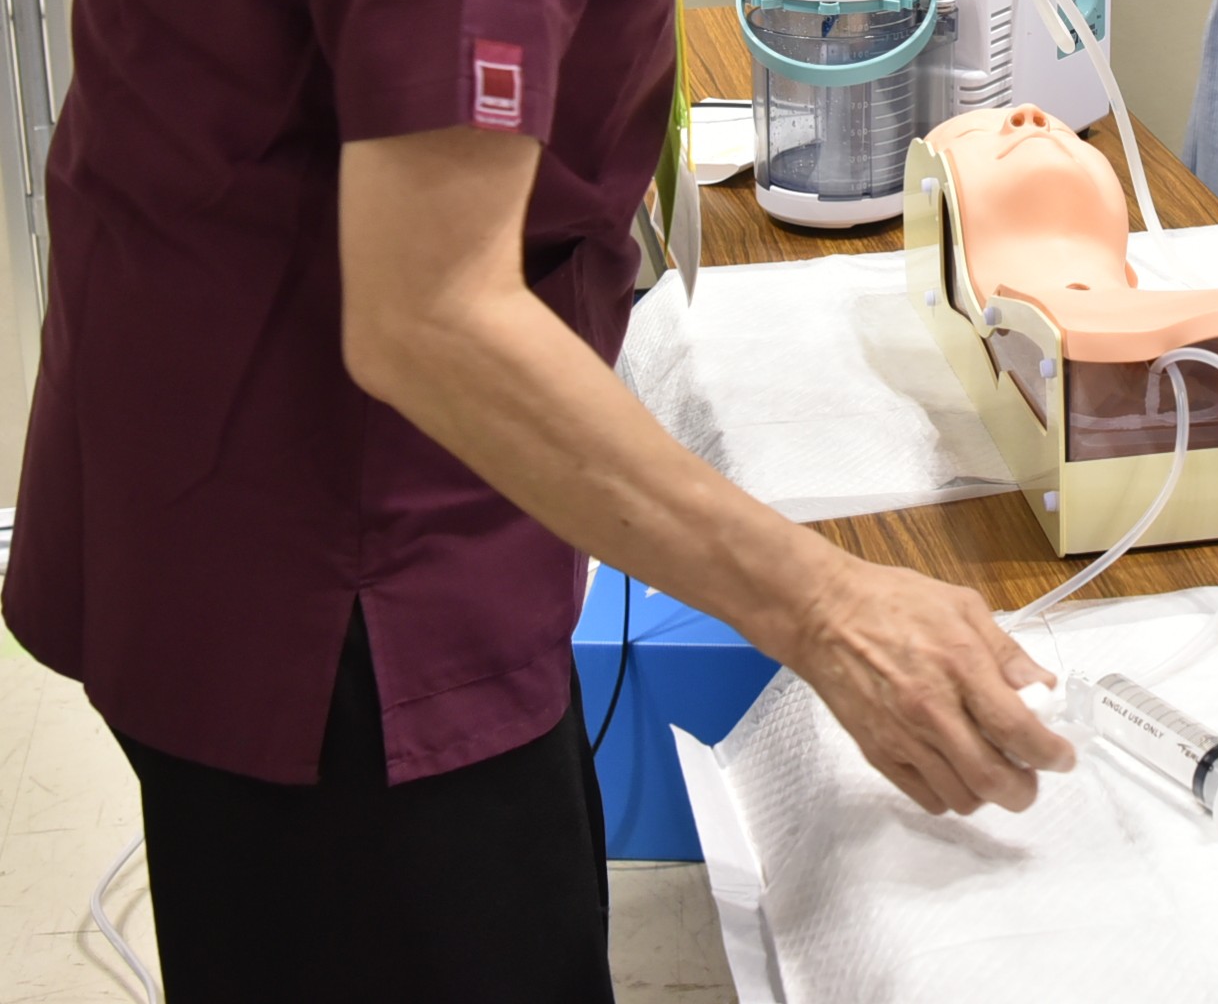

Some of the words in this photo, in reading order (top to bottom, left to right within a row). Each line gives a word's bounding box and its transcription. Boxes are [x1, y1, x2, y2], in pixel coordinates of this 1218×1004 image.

[1102, 696, 1128, 717] SINGLE
[1128, 713, 1144, 727] USE
[1143, 723, 1165, 739] ONLY
